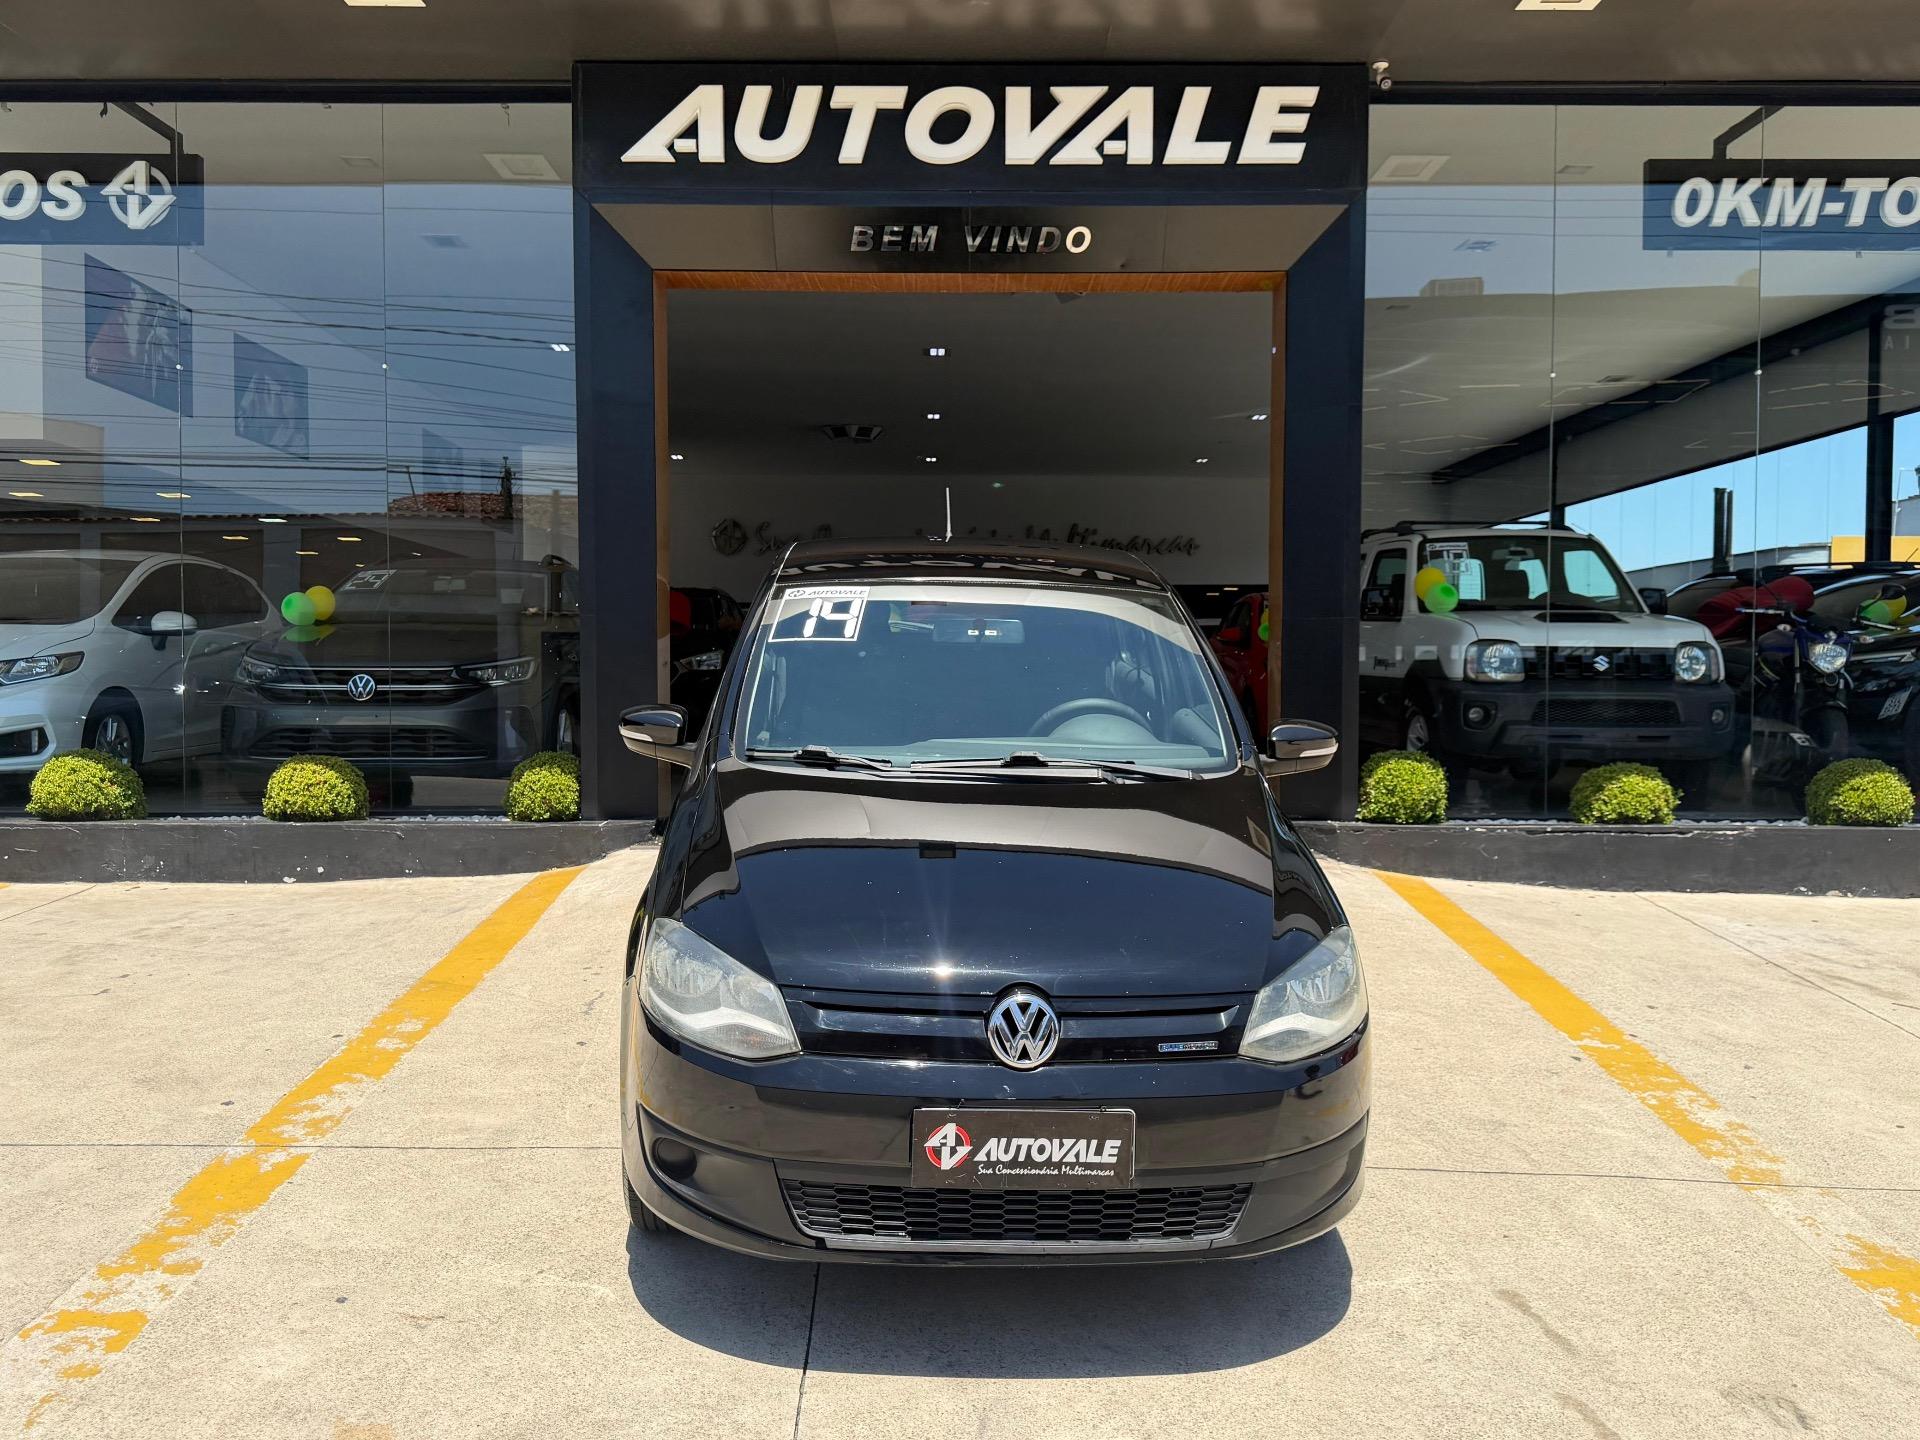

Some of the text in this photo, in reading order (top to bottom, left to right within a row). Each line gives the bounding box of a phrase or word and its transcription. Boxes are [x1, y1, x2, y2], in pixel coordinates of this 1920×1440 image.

[620, 83, 1321, 166] AUTOVALE
[850, 225, 1093, 255] BEM VINDO
[807, 588, 868, 597] AUTOVALE
[989, 995, 1058, 1067] VW
[973, 1137, 1122, 1164] AUTOVALE
[977, 1164, 1115, 1177] Sua Concessionária Multimarcas
